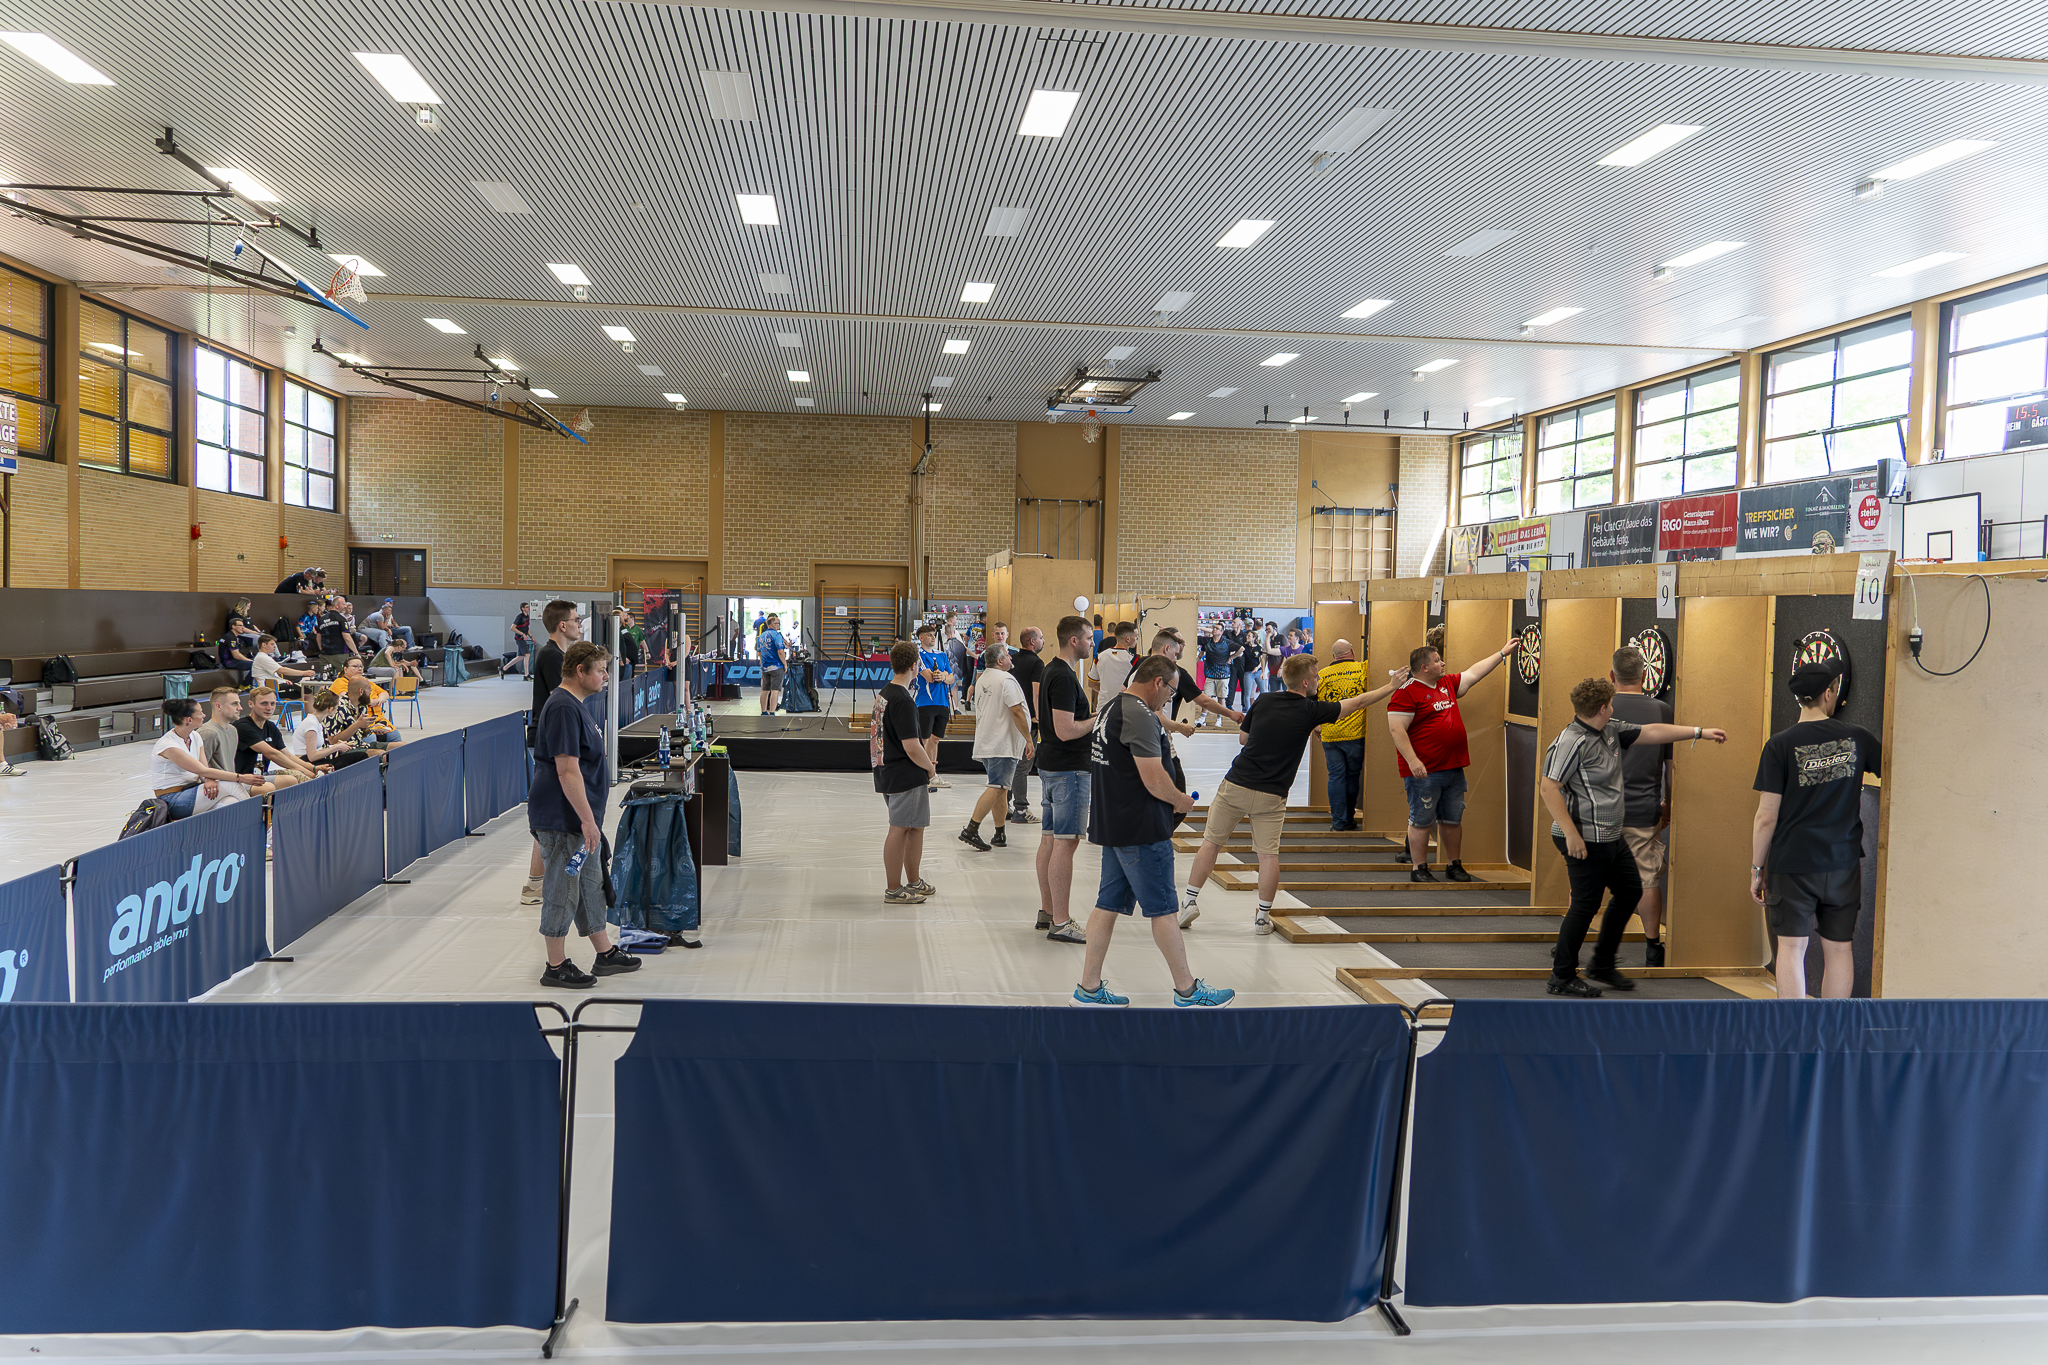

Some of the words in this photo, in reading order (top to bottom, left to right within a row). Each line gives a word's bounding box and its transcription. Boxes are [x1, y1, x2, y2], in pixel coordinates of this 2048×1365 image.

[1865, 497, 1876, 507] Wir
[1744, 507, 1795, 523] TREFFSICHER
[1860, 508, 1879, 518] stellen
[1592, 522, 1603, 535] Hey
[1626, 518, 1640, 529] baue
[1640, 516, 1653, 527] das
[1661, 518, 1682, 532] ERGO
[1864, 518, 1876, 527] ein!
[1520, 529, 1531, 539] DAS
[1759, 525, 1780, 539] WIR?
[1591, 536, 1616, 547] Gebäude
[1529, 588, 1535, 607] 8
[1661, 584, 1669, 607] 9
[1858, 577, 1880, 605] 10
[1434, 592, 1439, 608] 7
[1808, 754, 1848, 769] Dickies
